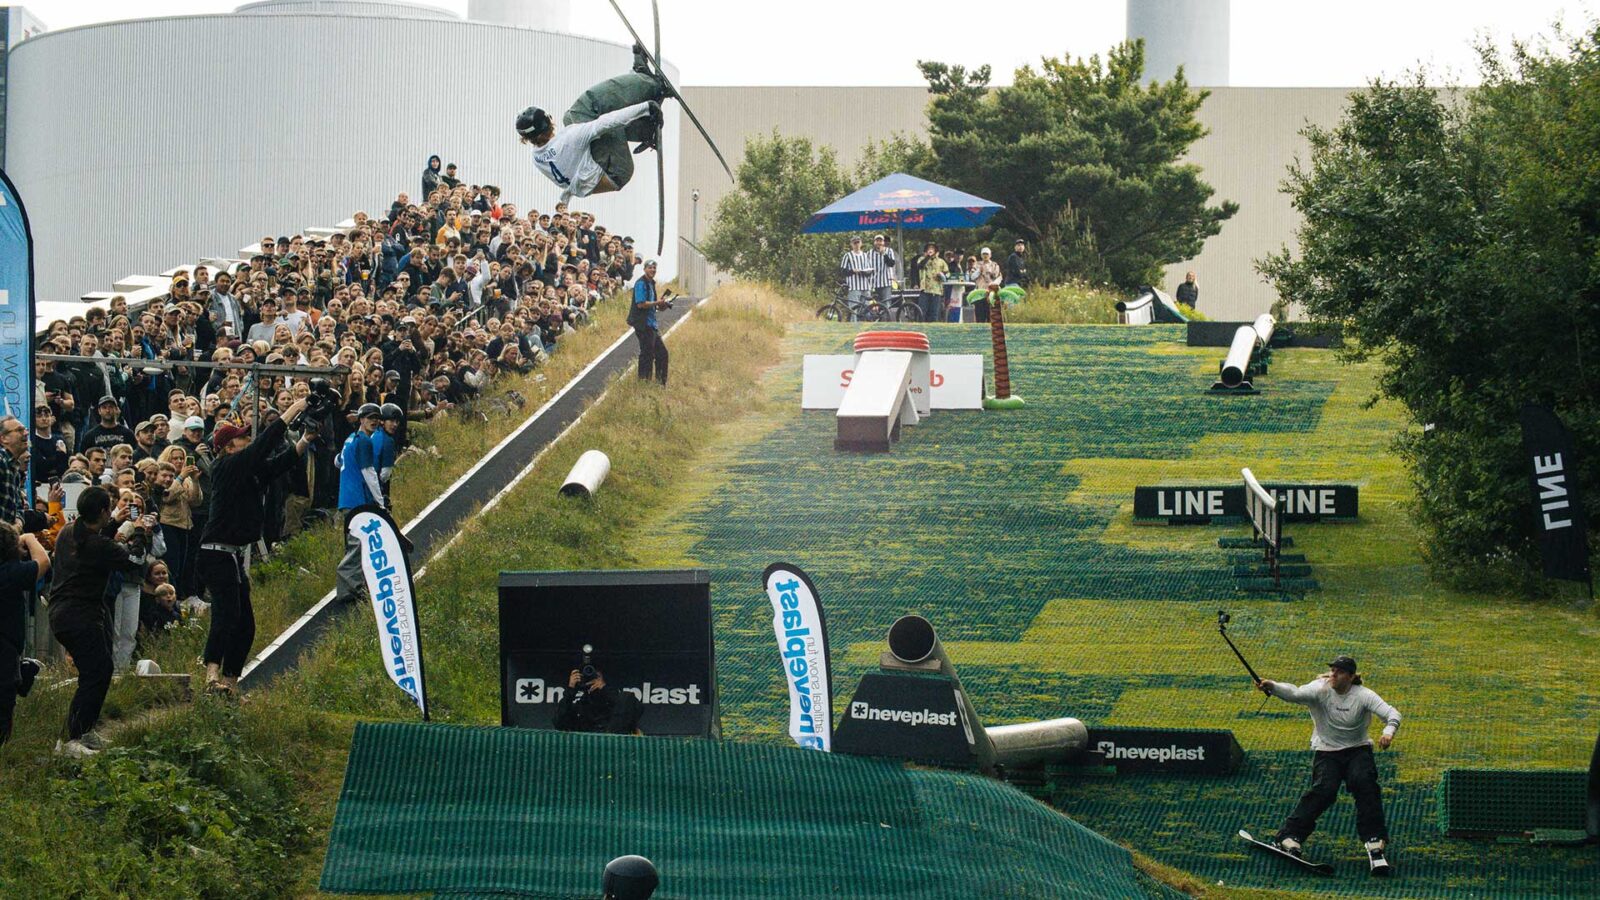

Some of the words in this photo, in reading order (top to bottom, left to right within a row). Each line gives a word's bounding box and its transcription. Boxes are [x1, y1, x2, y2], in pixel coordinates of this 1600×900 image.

[1157, 490, 1225, 516] LINE
[868, 708, 957, 726] neveplast
[1115, 744, 1205, 763] neveplast
